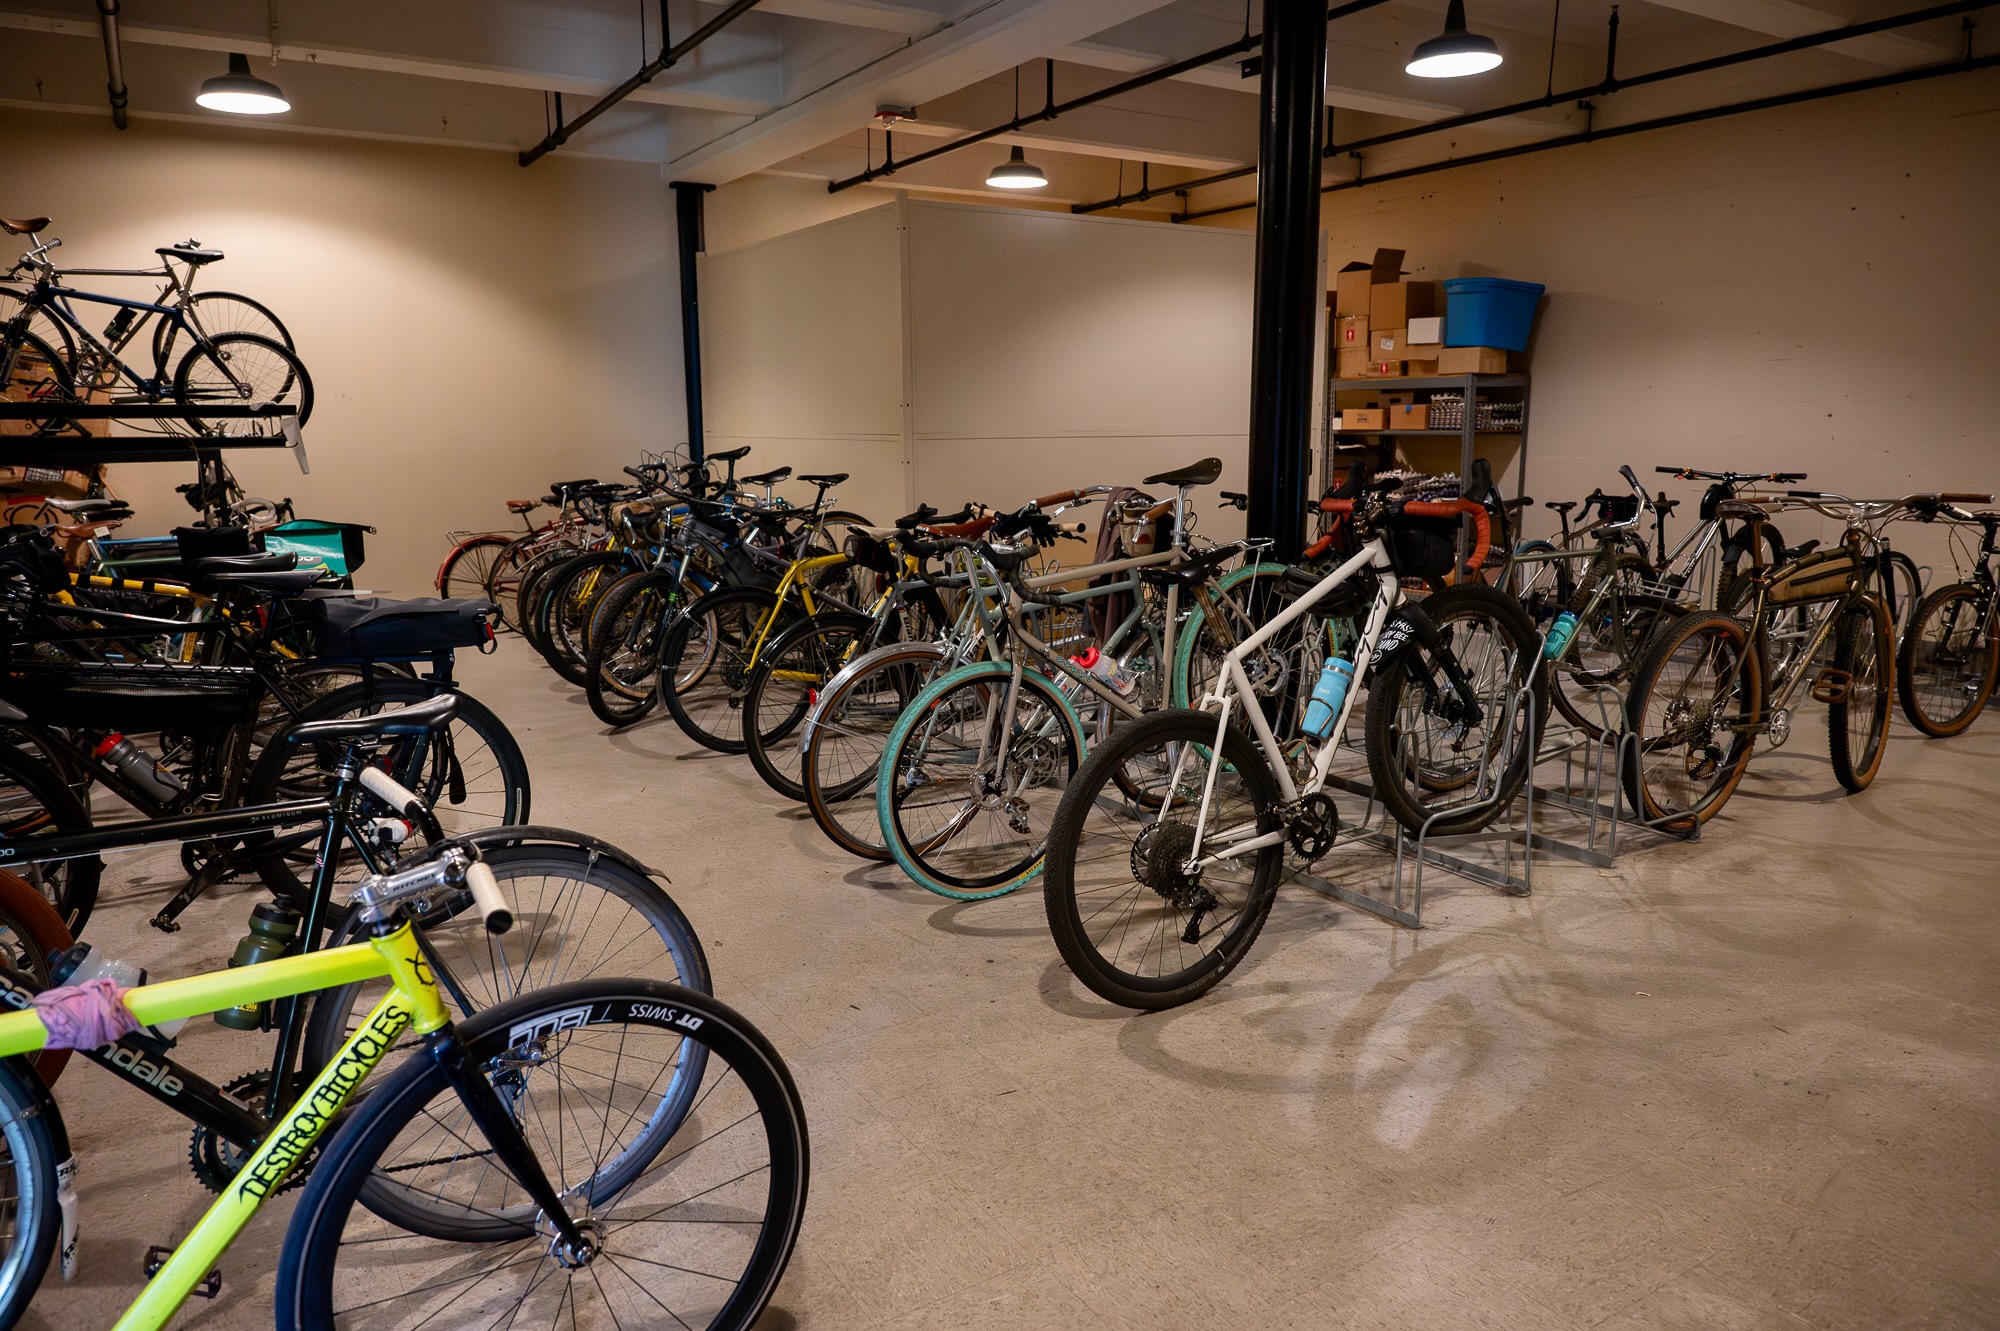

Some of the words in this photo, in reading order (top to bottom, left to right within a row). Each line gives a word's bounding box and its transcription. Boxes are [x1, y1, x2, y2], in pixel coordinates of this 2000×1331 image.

[262, 809, 303, 821] ALUMINUM
[392, 873, 437, 892] RITCHEY
[628, 1003, 678, 1023] SWISS
[675, 1013, 705, 1032] DT
[239, 1088, 333, 1205] DESTROY
[317, 1004, 411, 1112] BICYCLES
